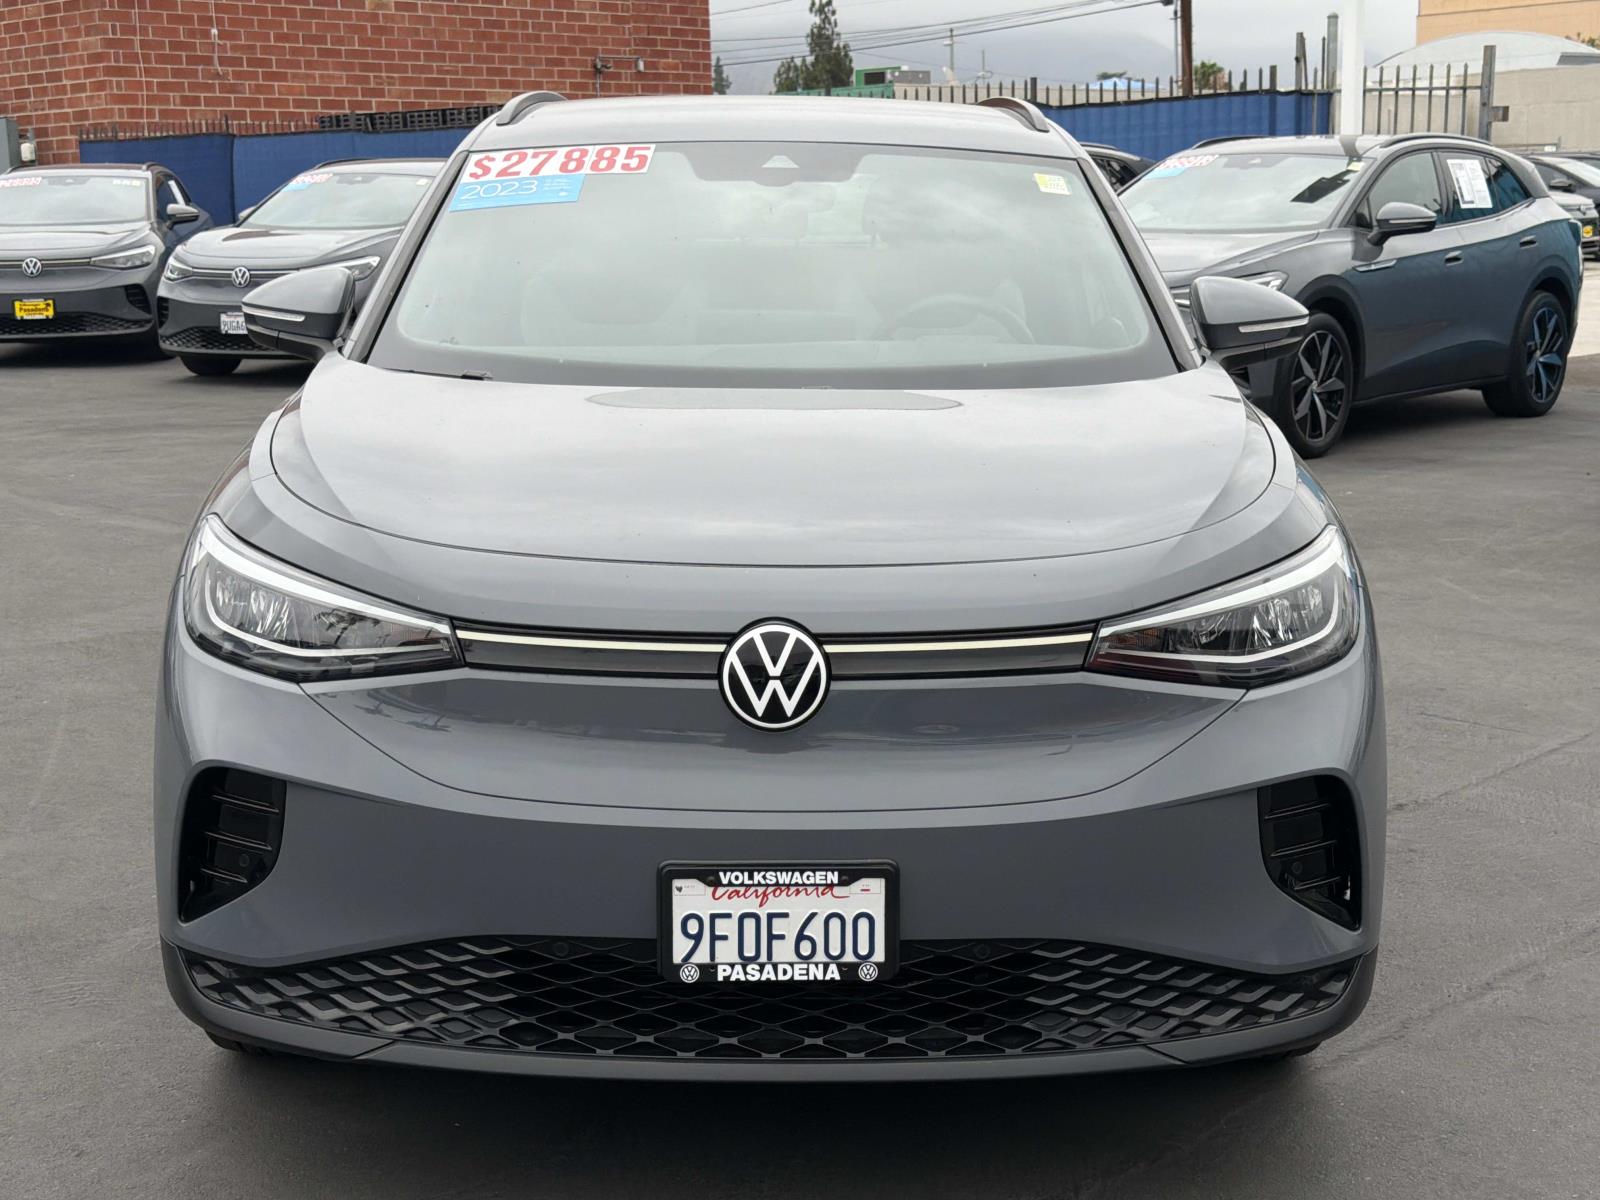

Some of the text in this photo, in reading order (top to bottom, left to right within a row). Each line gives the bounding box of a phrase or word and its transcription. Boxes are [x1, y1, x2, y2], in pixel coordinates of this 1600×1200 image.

[469, 146, 651, 179] $27885
[461, 180, 538, 200] 2023
[723, 625, 826, 728] VW
[718, 871, 839, 885] VOLKSWAGEN
[712, 884, 850, 908] California
[717, 963, 841, 981] PASADENA
